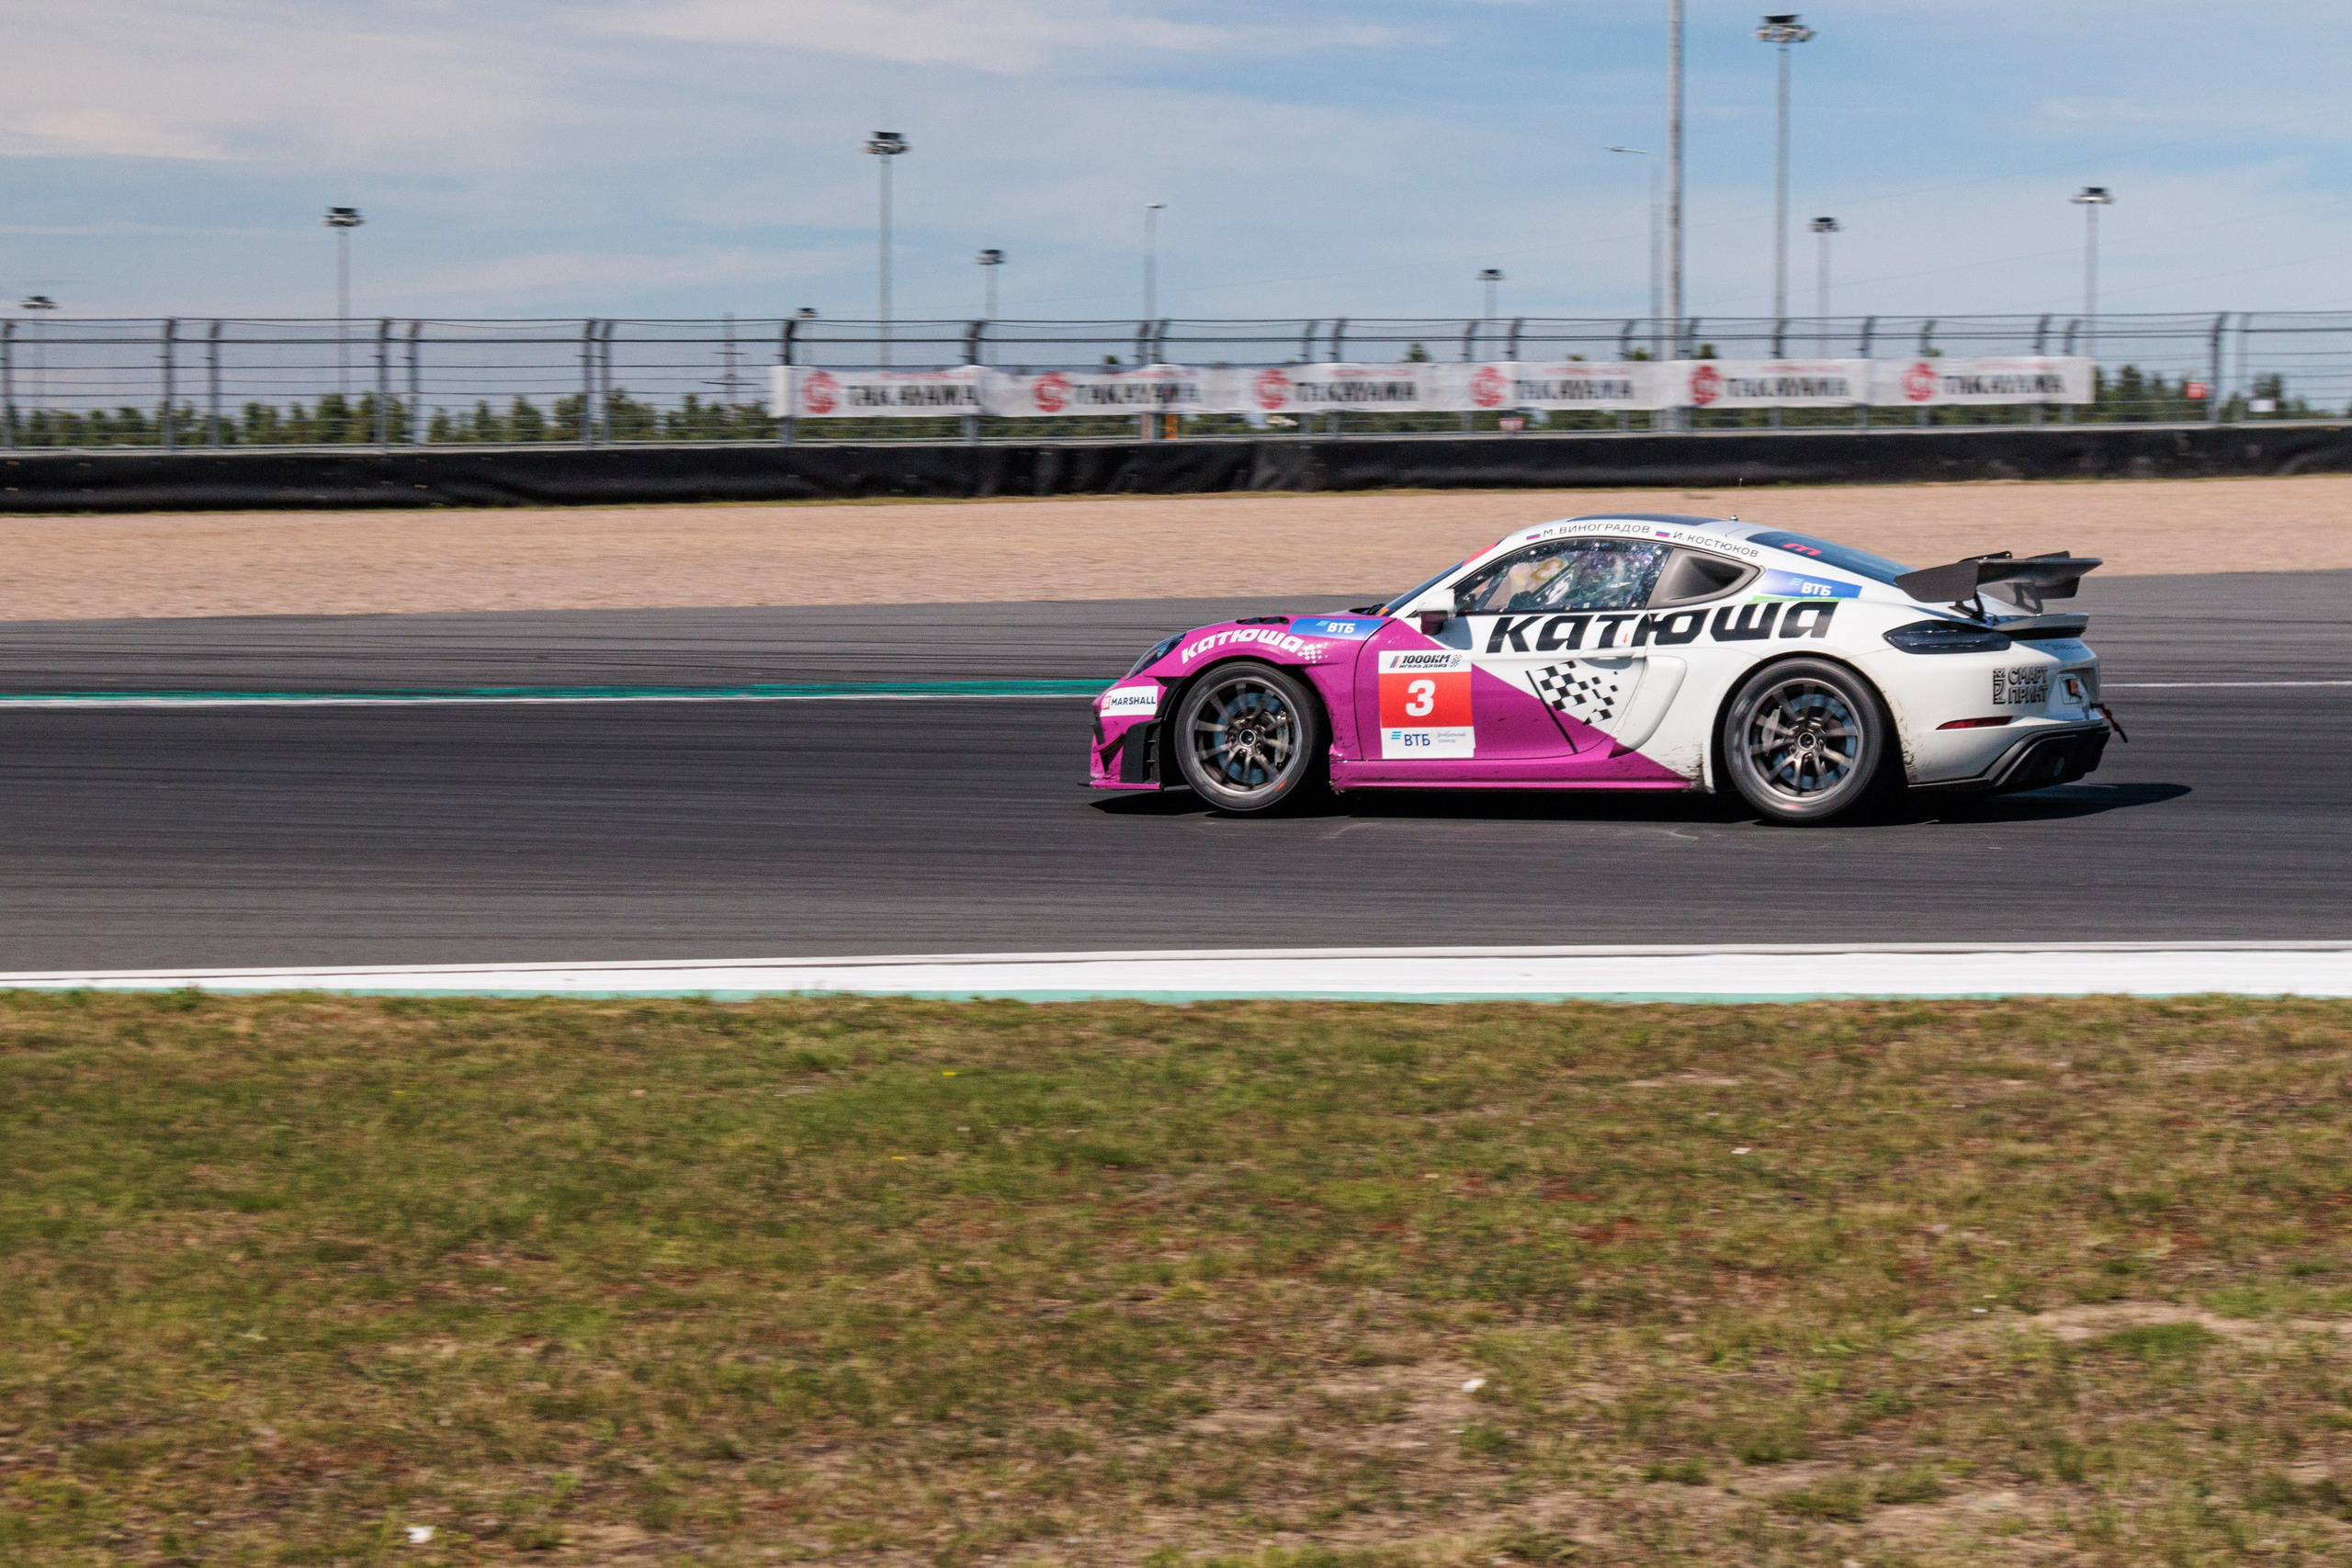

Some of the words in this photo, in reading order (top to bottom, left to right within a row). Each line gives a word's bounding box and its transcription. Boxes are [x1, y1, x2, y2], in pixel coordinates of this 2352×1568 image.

[1559, 524, 1650, 534] ВИНОГРАДОВ
[1688, 535, 1758, 558] КОСТЮКОВ
[1801, 581, 1832, 597] ВТБ
[1327, 622, 1356, 634] ВТБ
[2007, 666, 2048, 685] СМАРТ
[1111, 696, 1156, 706] MARSHALL
[1406, 679, 1436, 716] 3
[2007, 684, 2048, 705] ПРИНТ
[1404, 734, 1430, 746] ВТБ
